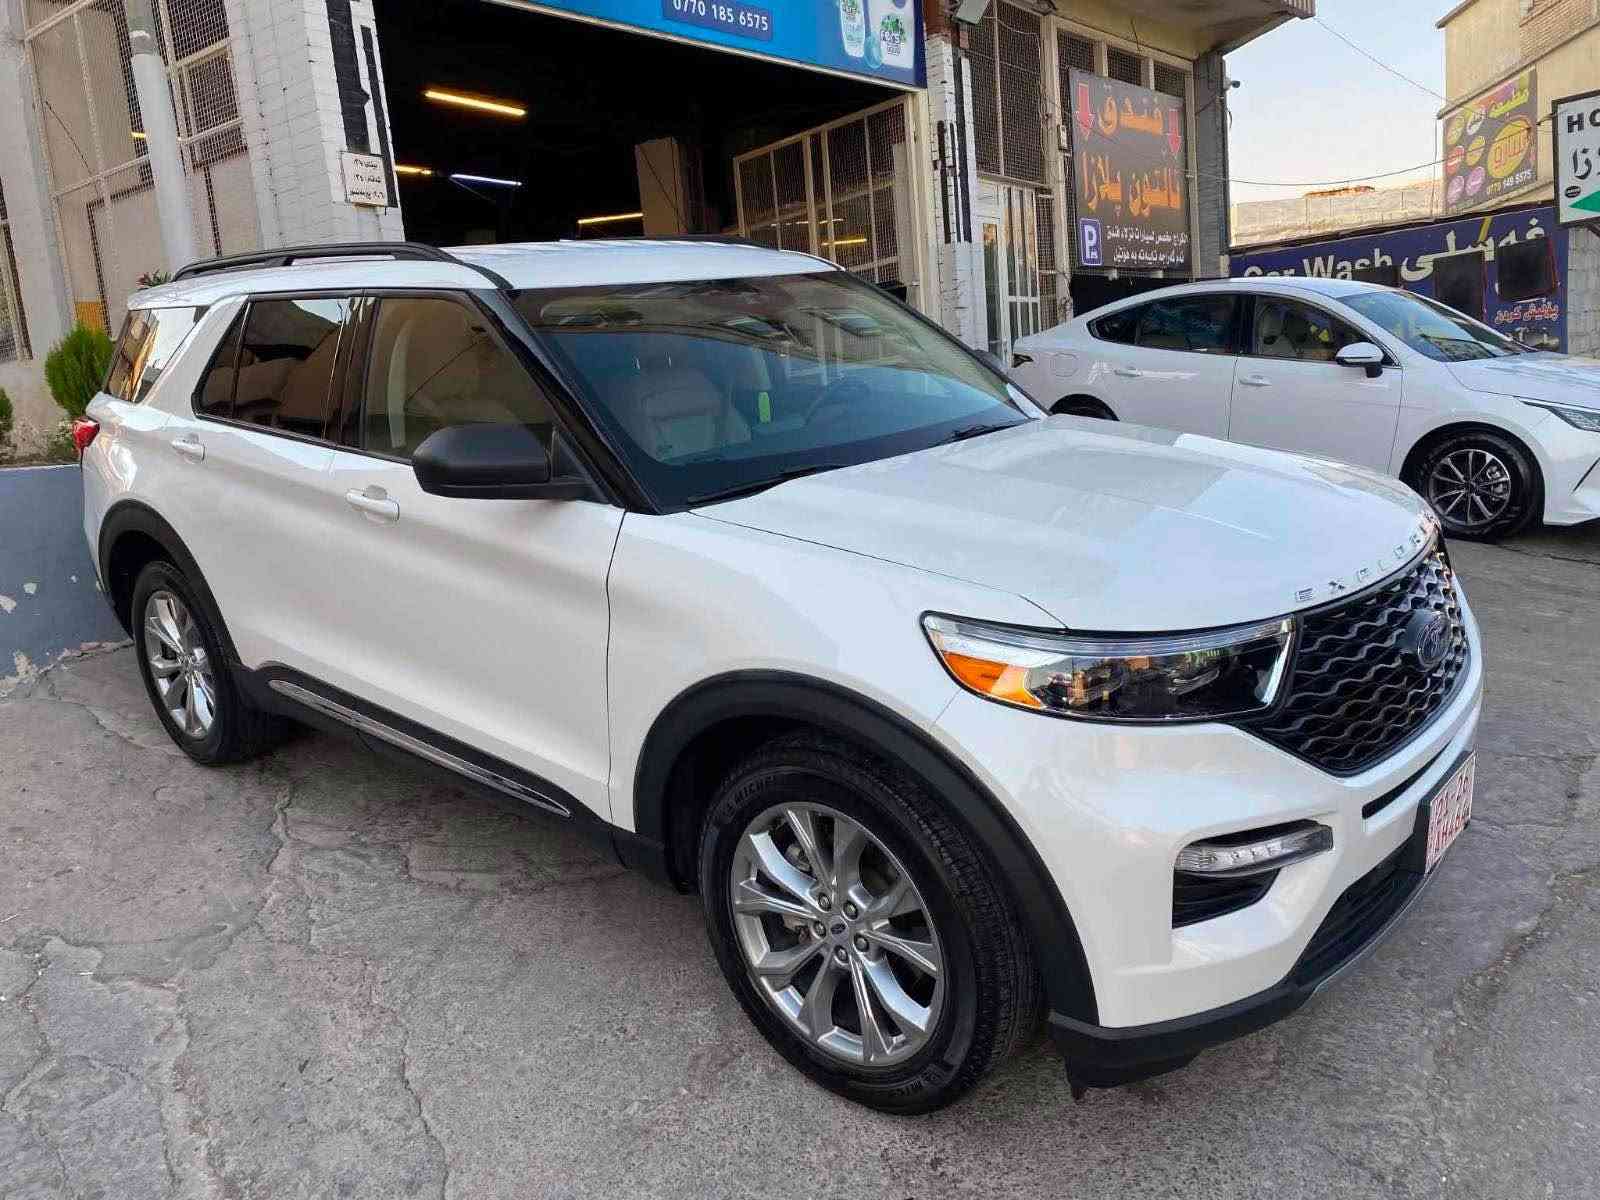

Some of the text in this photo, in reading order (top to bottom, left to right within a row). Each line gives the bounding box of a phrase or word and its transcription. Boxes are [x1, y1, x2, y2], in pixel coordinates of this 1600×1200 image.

[673, 0, 769, 31] 0770 185 6575
[1099, 83, 1164, 136] فندق
